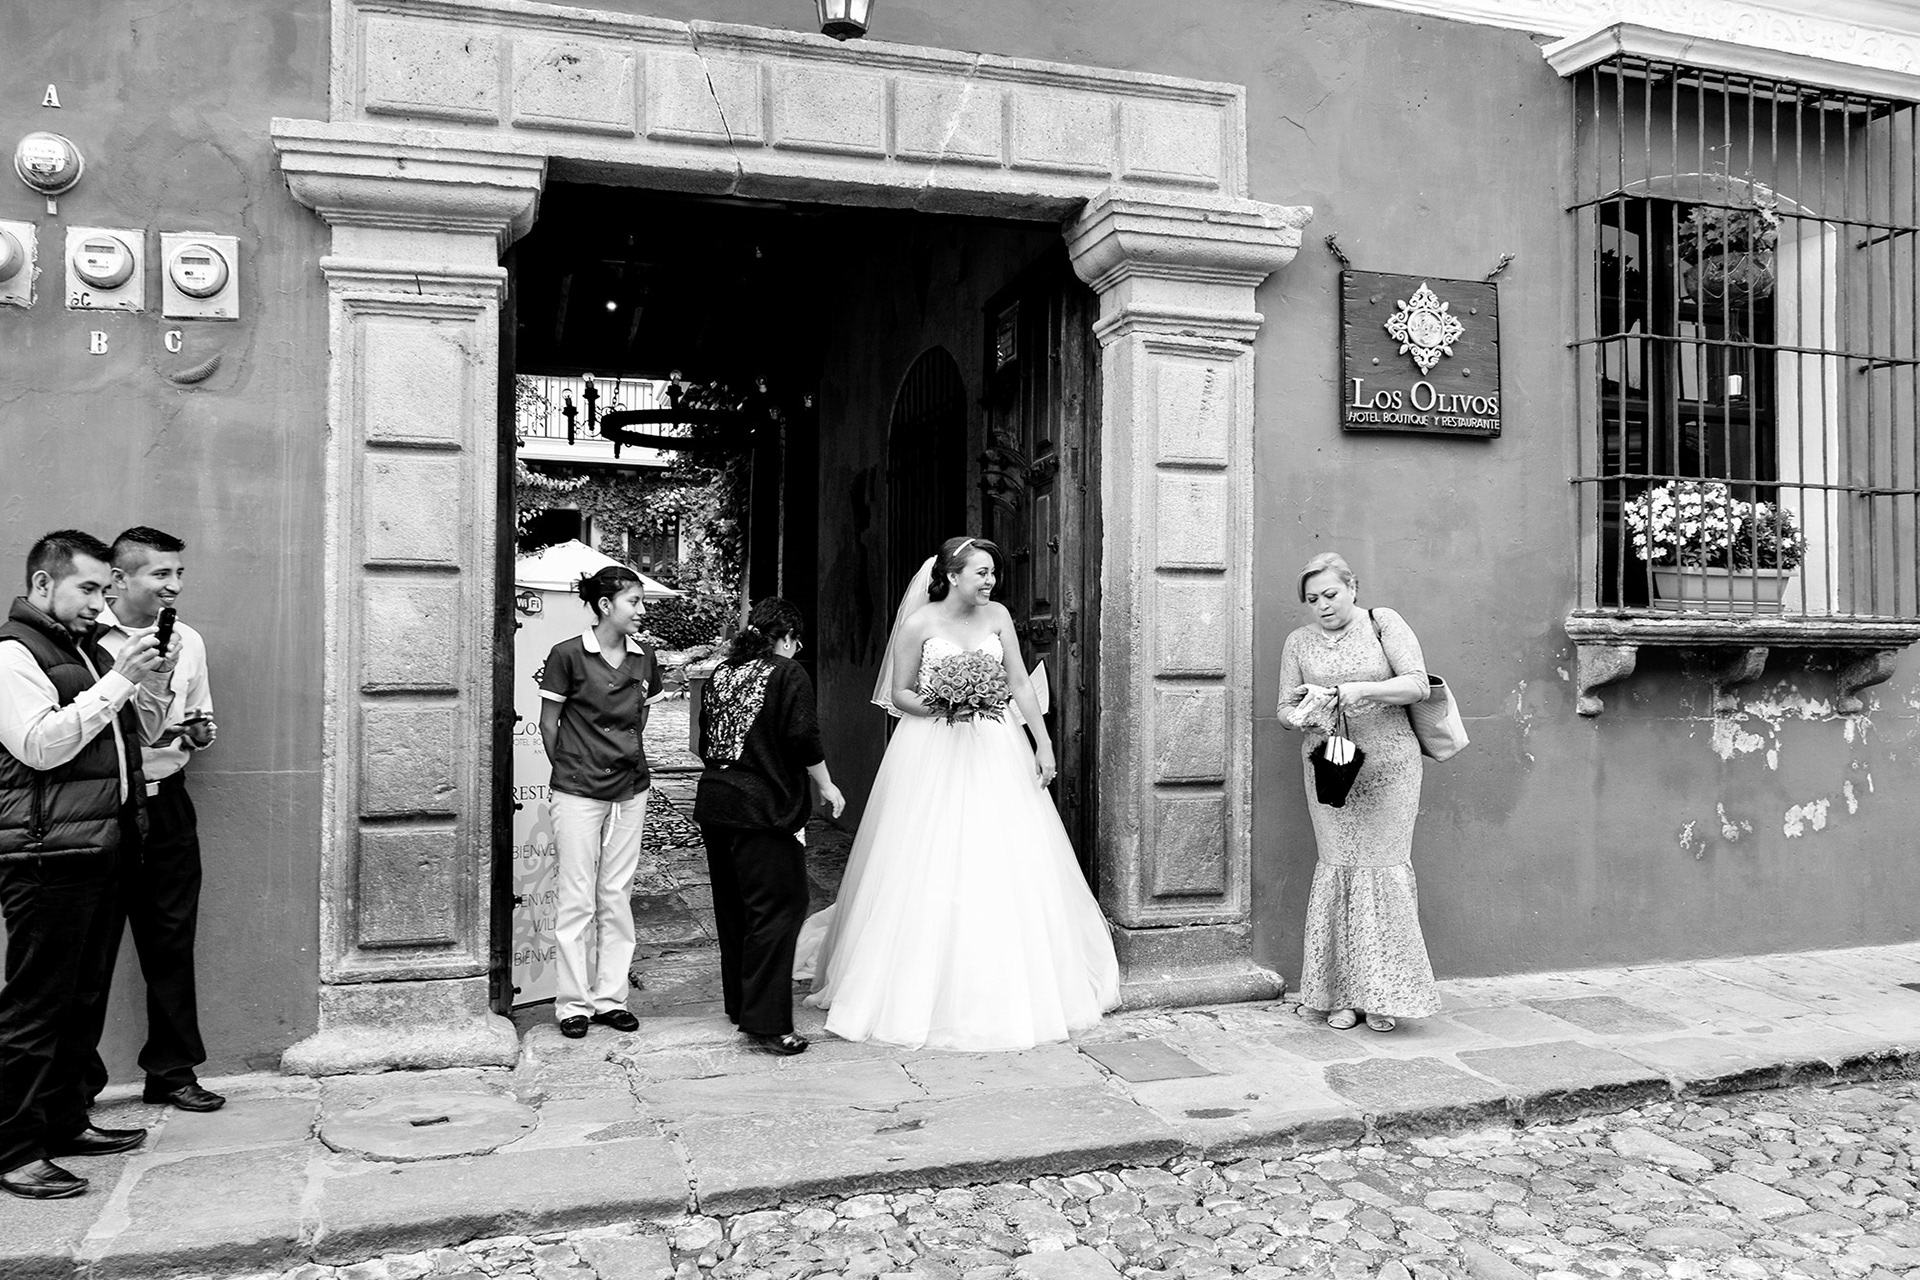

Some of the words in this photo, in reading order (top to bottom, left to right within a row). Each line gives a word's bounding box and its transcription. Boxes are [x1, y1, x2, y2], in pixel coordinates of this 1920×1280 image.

[42, 84, 61, 108] A
[88, 330, 108, 355] B
[163, 330, 183, 353] C
[1352, 377, 1402, 409] LOS
[1410, 381, 1499, 415] OLIVOS
[1349, 411, 1380, 423] HOTEL
[1383, 412, 1429, 426] BOUTIQUE
[1433, 416, 1440, 426] Y
[1442, 416, 1500, 430] RESTAURANTE
